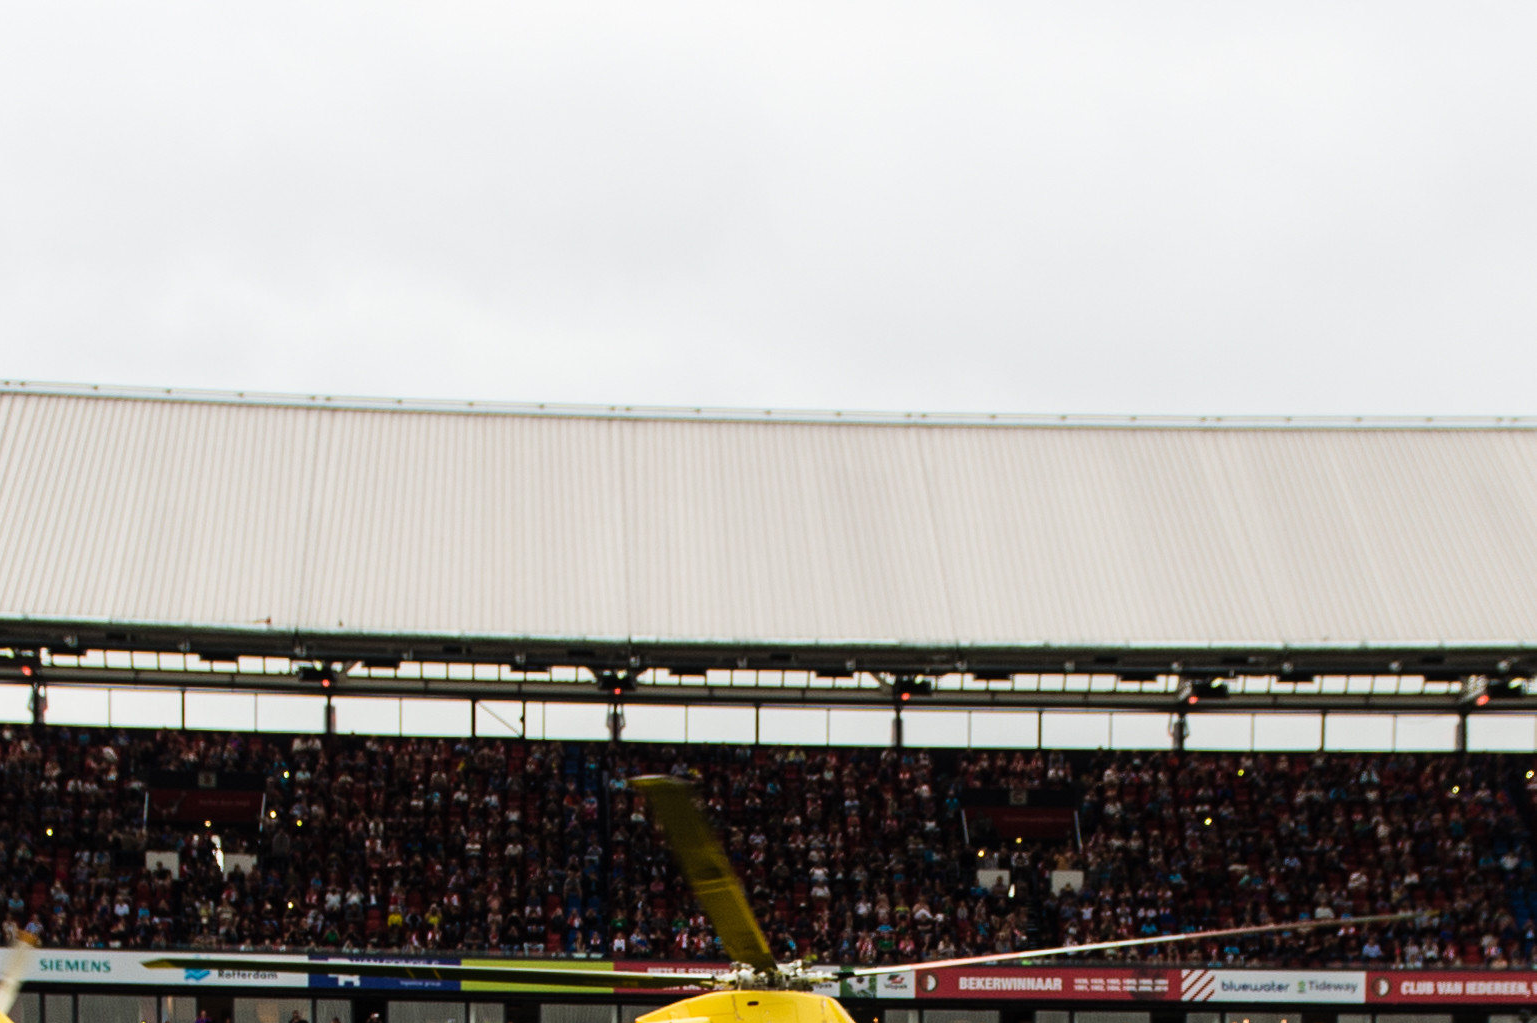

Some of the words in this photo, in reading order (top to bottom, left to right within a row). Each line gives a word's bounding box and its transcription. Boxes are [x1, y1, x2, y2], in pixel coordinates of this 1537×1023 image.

[39, 958, 112, 973] SIEMENS
[217, 969, 279, 980] Rotterdam
[958, 976, 1063, 992] BEKERWINNAAR
[1220, 979, 1291, 993] bluewater
[1309, 979, 1359, 994] Tideway
[1400, 981, 1435, 995] CLUB
[1436, 981, 1463, 996] VAN
